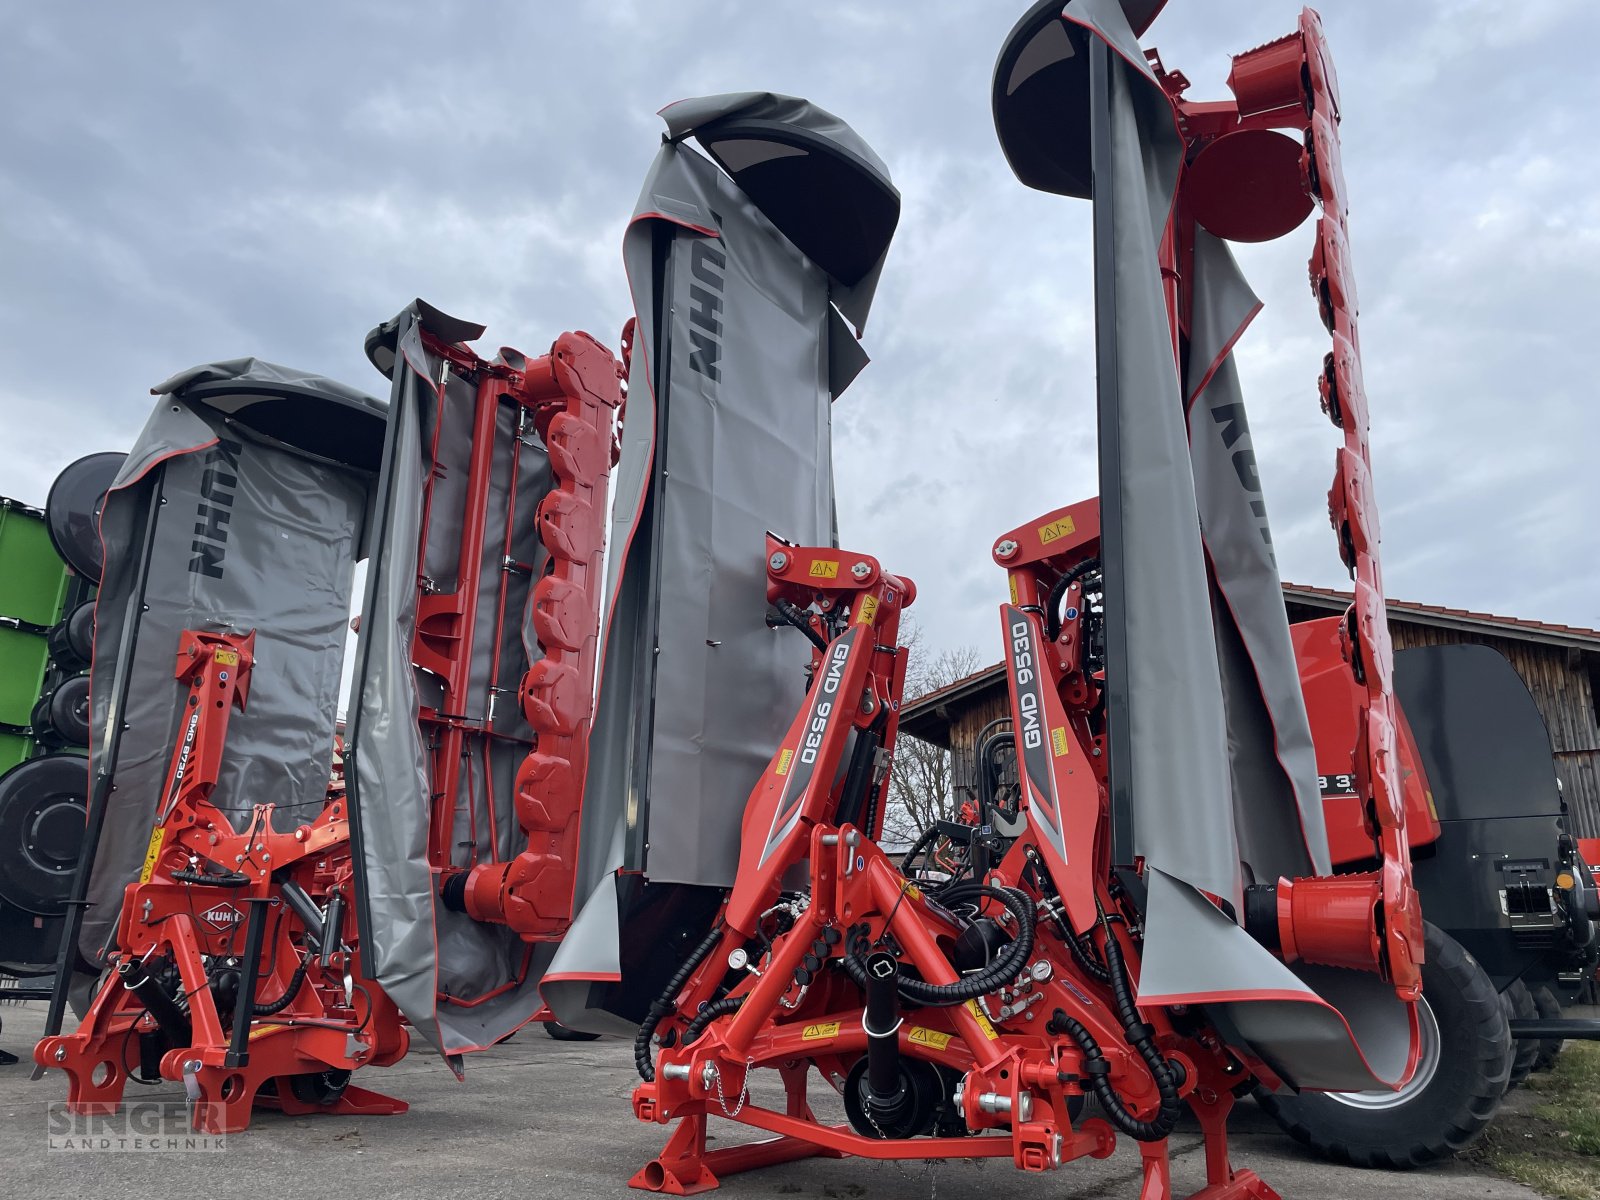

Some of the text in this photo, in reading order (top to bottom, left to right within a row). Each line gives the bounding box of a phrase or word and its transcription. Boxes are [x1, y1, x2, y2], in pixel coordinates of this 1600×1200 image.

[801, 643, 850, 764] GMD 9530
[1012, 621, 1041, 749] GMD 9530
[186, 714, 199, 742] GMD
[207, 911, 239, 922] KUHN
